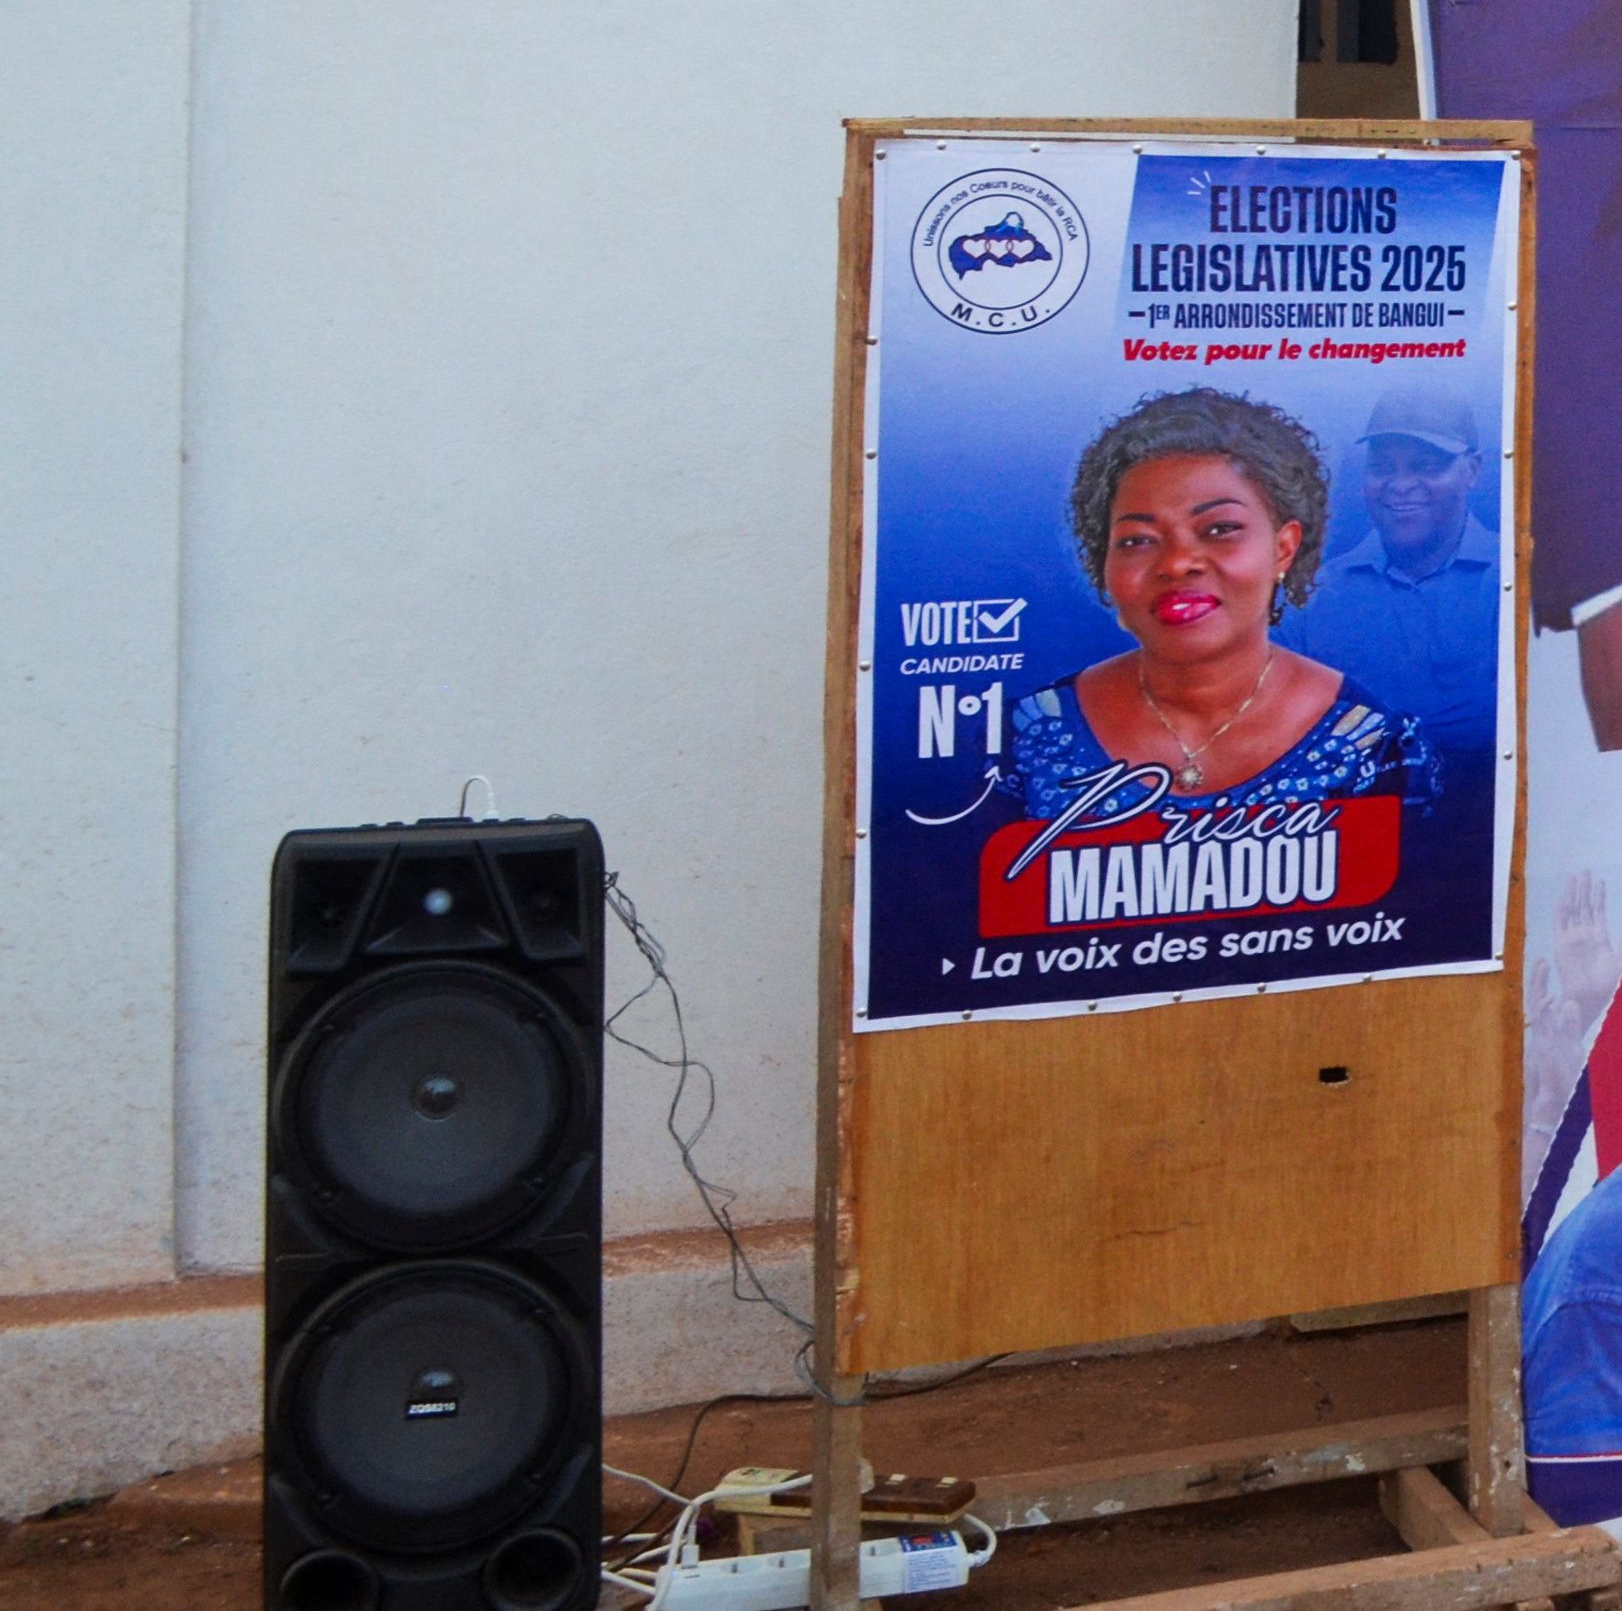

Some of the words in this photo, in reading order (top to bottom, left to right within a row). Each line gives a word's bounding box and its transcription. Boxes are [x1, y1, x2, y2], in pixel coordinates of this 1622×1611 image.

[923, 203, 952, 247] Unissons
[951, 191, 969, 206] nos
[1011, 180, 1036, 194] pour
[1056, 206, 1066, 219] la
[1061, 216, 1079, 242] RCA
[1209, 185, 1398, 234] ELECTIONS
[1131, 243, 1373, 293] LEGISLATIVES
[1380, 244, 1466, 293] 2025
[1173, 302, 1347, 329] ARRONDISSEMENT
[1351, 302, 1375, 328] DE
[1378, 302, 1445, 328] BANGUI
[1123, 338, 1198, 362] Votez
[1204, 340, 1272, 366] pour
[1278, 338, 1303, 360] le
[1307, 337, 1467, 364] changement
[900, 601, 973, 647] VOTE
[899, 652, 1025, 676] CANDIDATE
[1006, 759, 1342, 880] Prisca
[1048, 830, 1338, 924] MAMADOU
[970, 946, 1024, 980] La
[1035, 936, 1122, 971] voix
[1131, 932, 1207, 966] des
[1219, 923, 1314, 958] sans
[1325, 911, 1407, 947] voix
